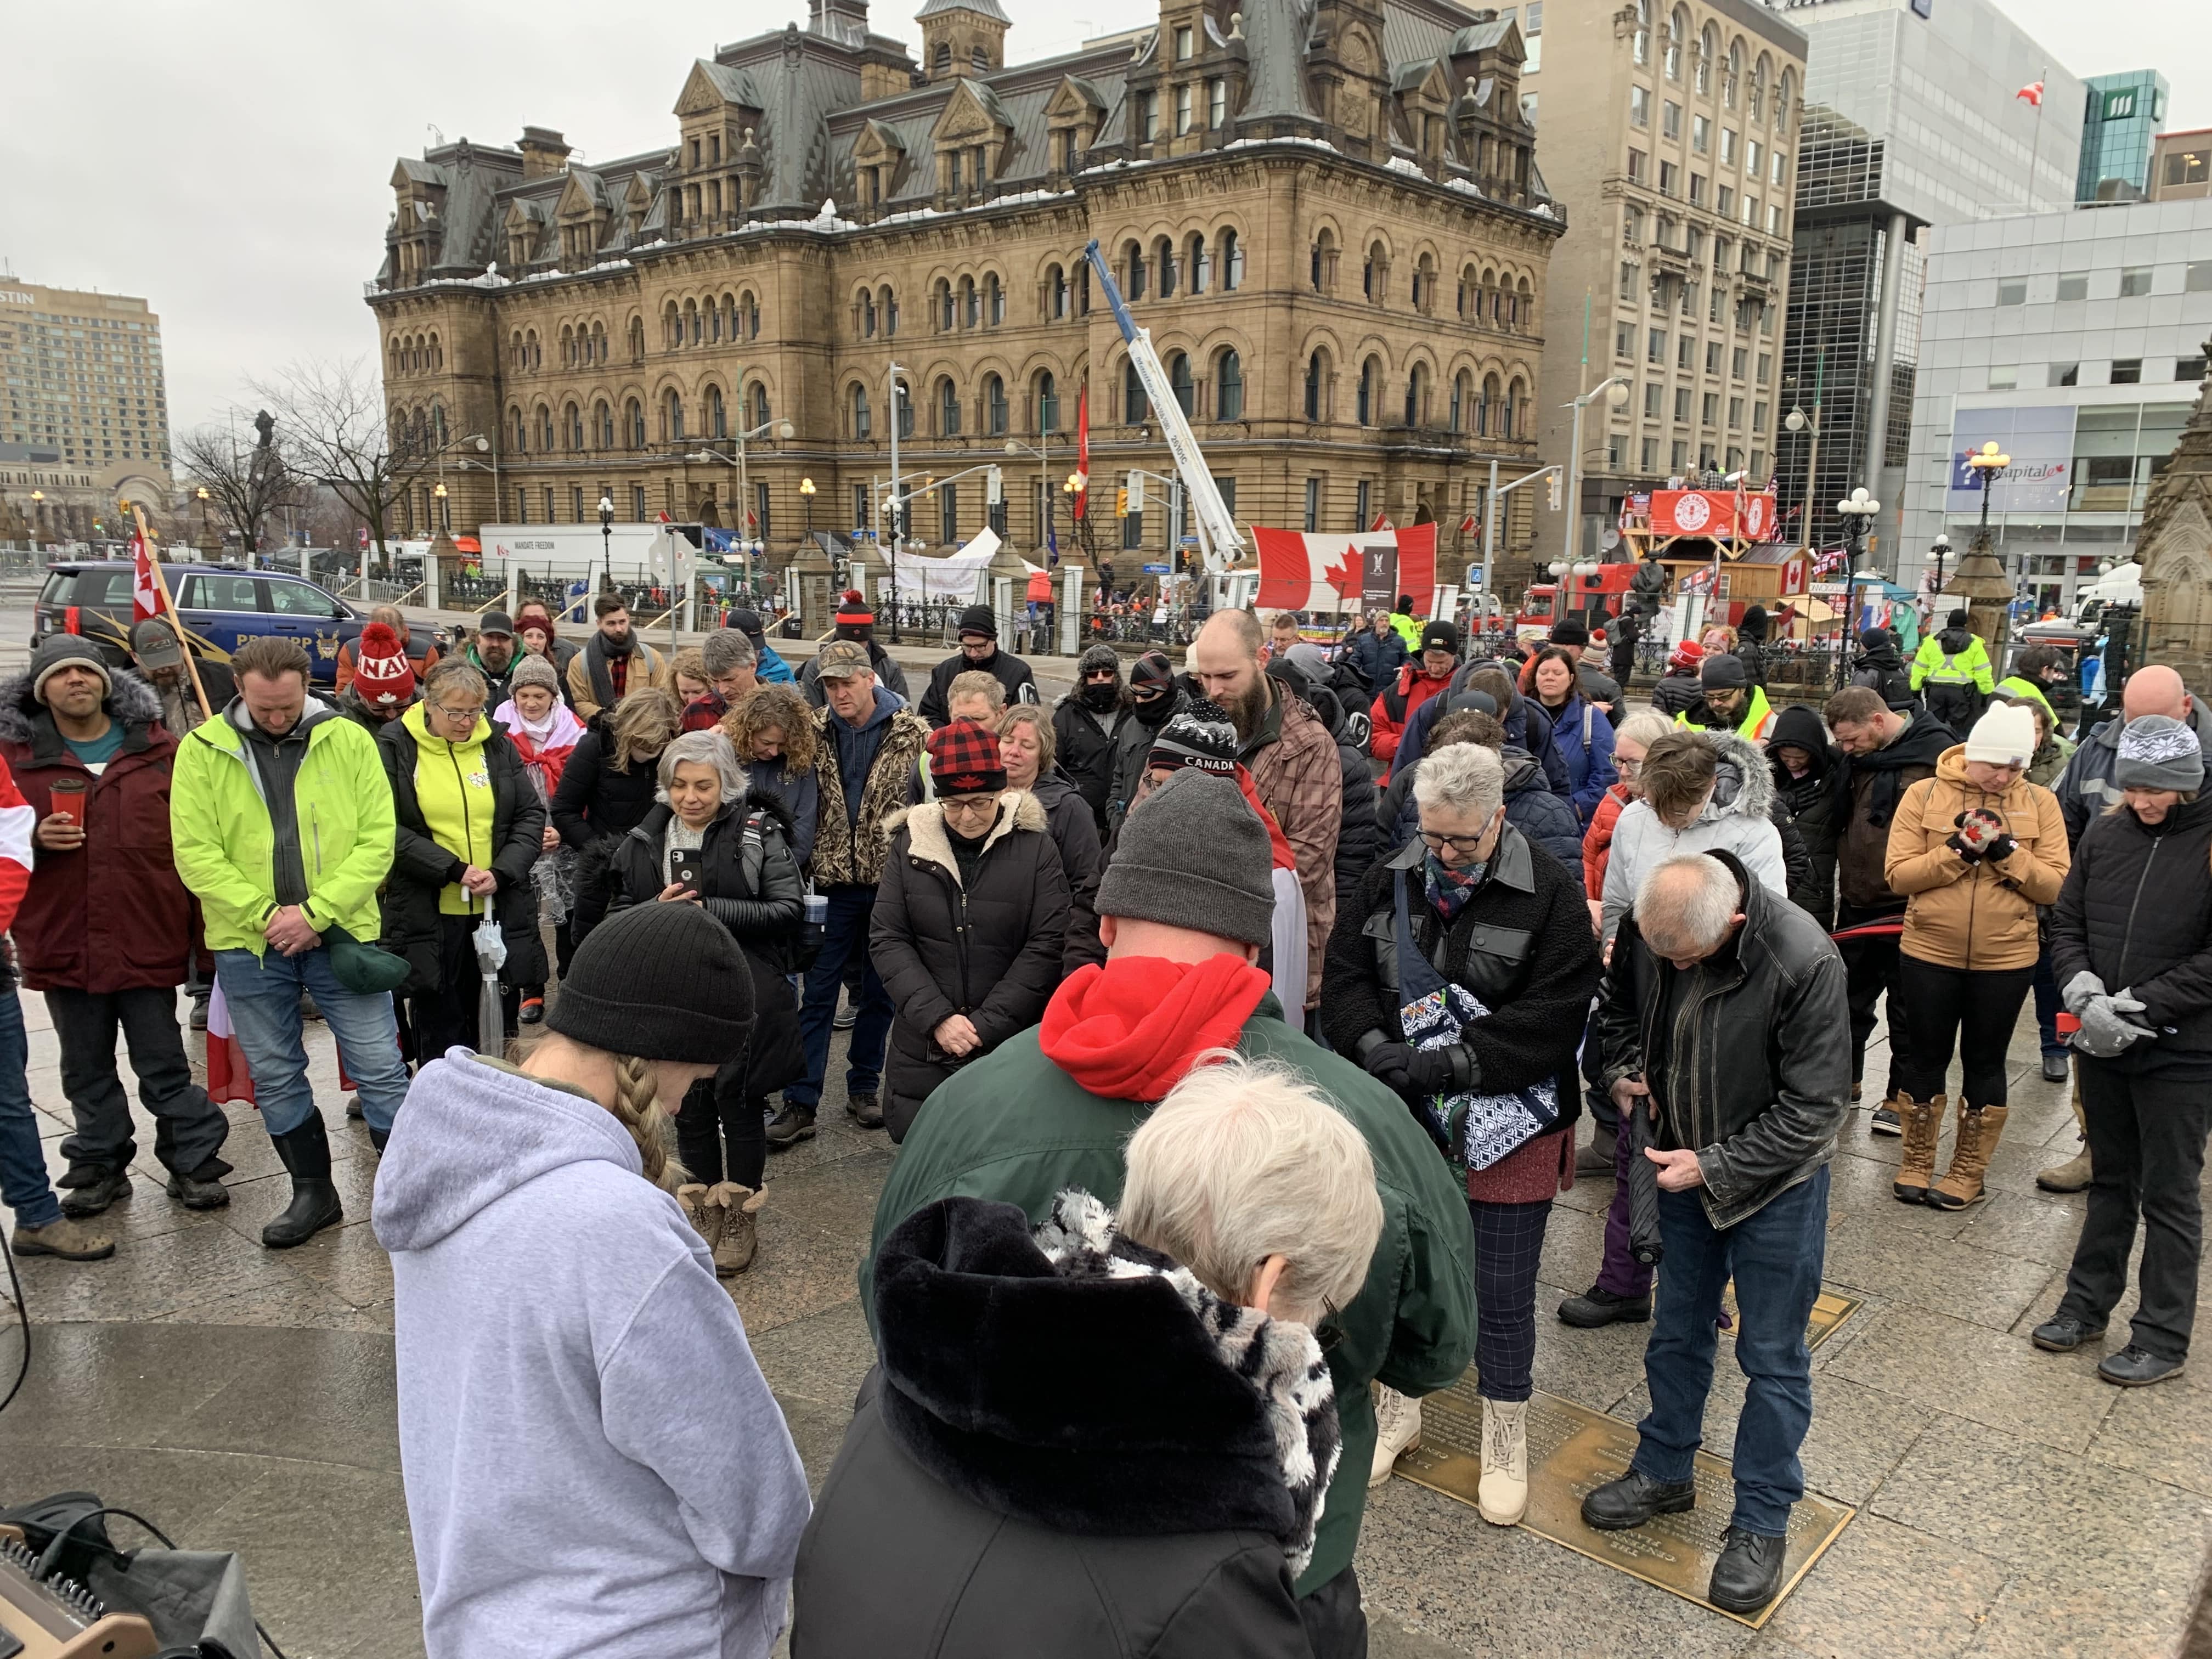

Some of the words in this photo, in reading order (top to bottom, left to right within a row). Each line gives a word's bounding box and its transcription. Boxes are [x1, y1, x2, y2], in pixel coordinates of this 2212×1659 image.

[1679, 496, 1690, 509] LIVE
[1692, 496, 1708, 510] FROM
[514, 541, 534, 549] MANDATE
[535, 541, 555, 549] FREEDOM
[1185, 757, 1234, 770] CANADA
[1589, 1521, 1679, 1565] CENTENN
[1608, 1539, 1640, 1558] THE
